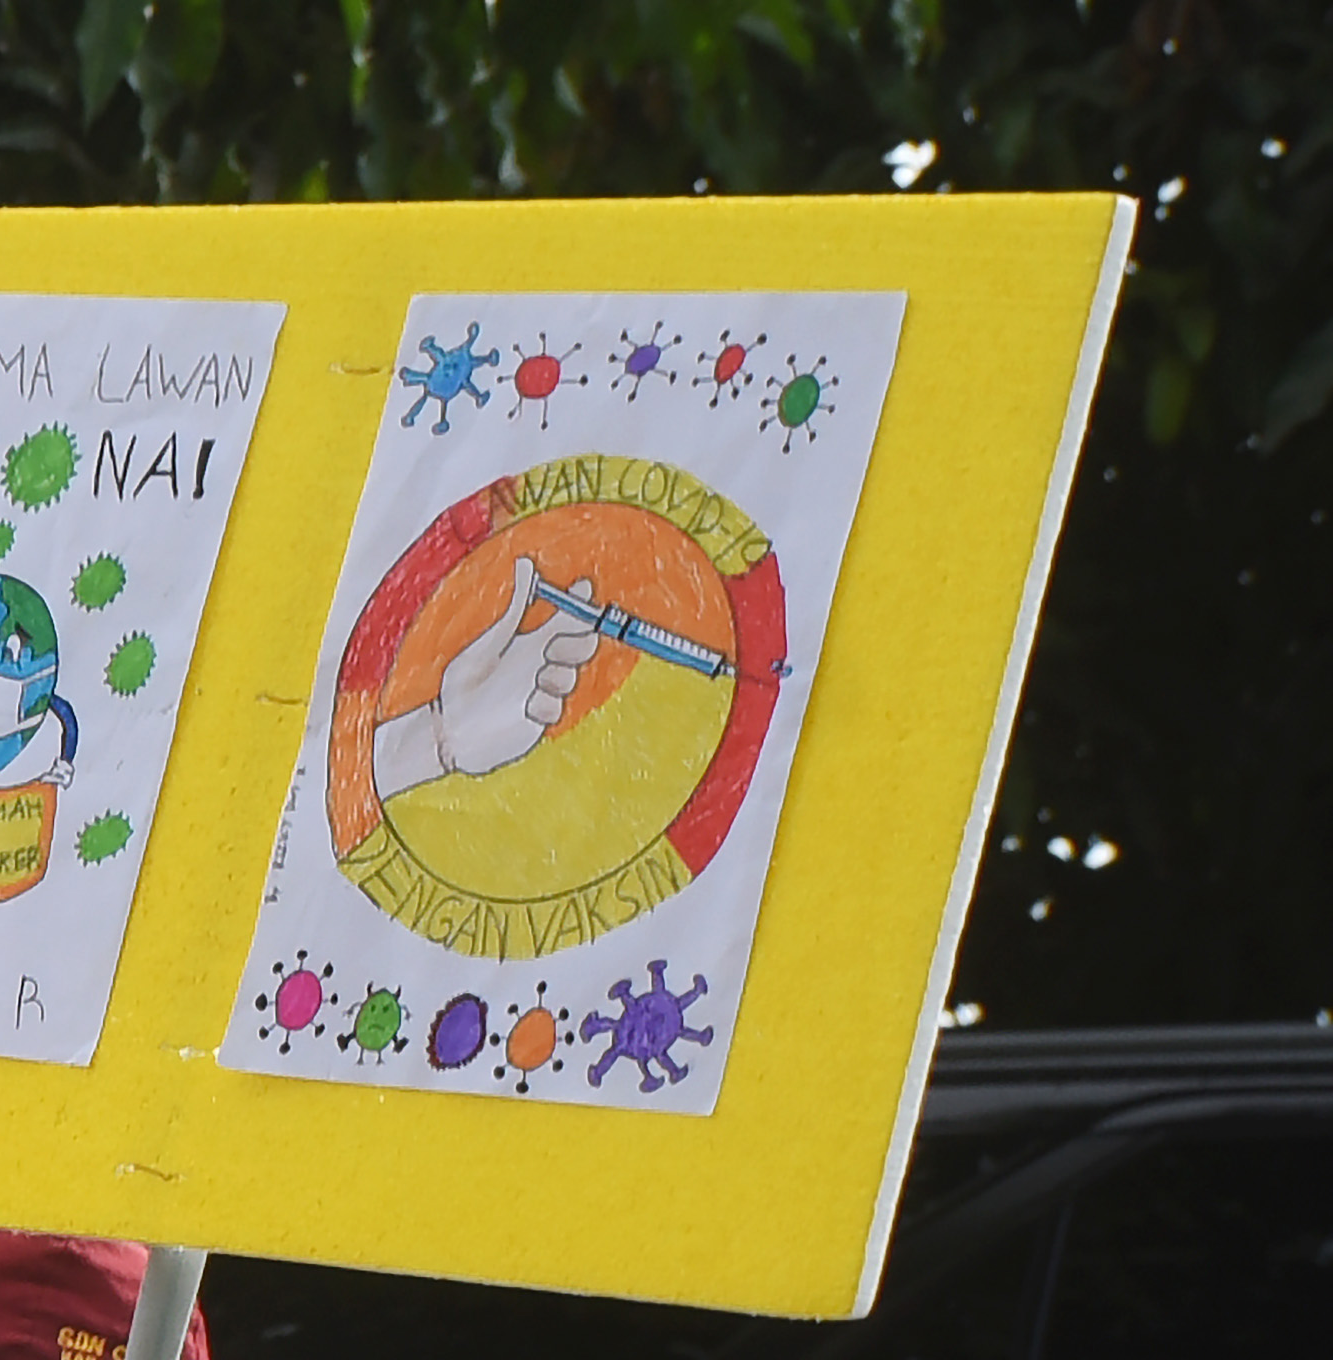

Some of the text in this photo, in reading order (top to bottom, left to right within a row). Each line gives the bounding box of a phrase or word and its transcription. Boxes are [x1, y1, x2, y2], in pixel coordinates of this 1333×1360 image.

[93, 342, 254, 408] LAWAN
[336, 823, 510, 965] DENGAN
[526, 846, 682, 960] VAKSIN
[15, 974, 45, 1030] R
